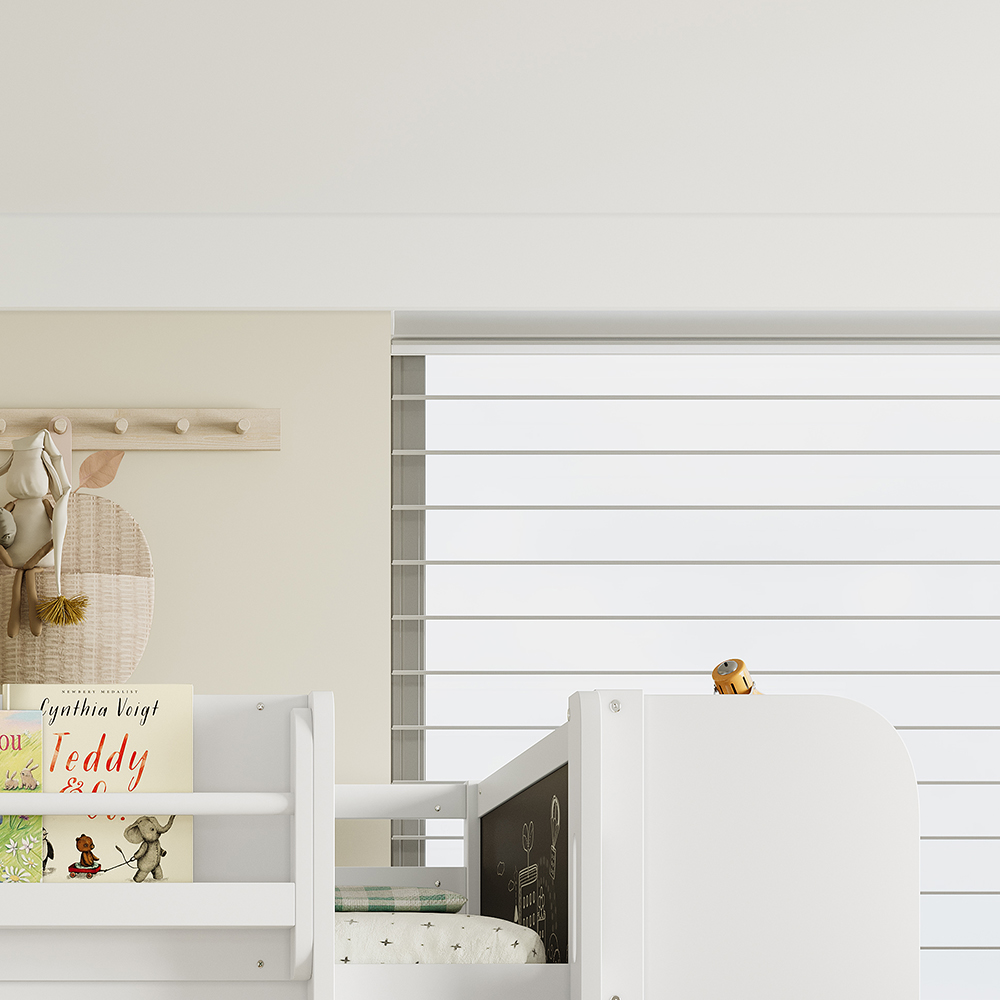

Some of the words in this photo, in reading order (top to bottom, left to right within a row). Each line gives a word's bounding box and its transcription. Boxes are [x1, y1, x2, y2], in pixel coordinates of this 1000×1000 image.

[39, 697, 108, 727] Cynthia
[116, 697, 160, 727] Voigt
[49, 732, 149, 793] Teddy
